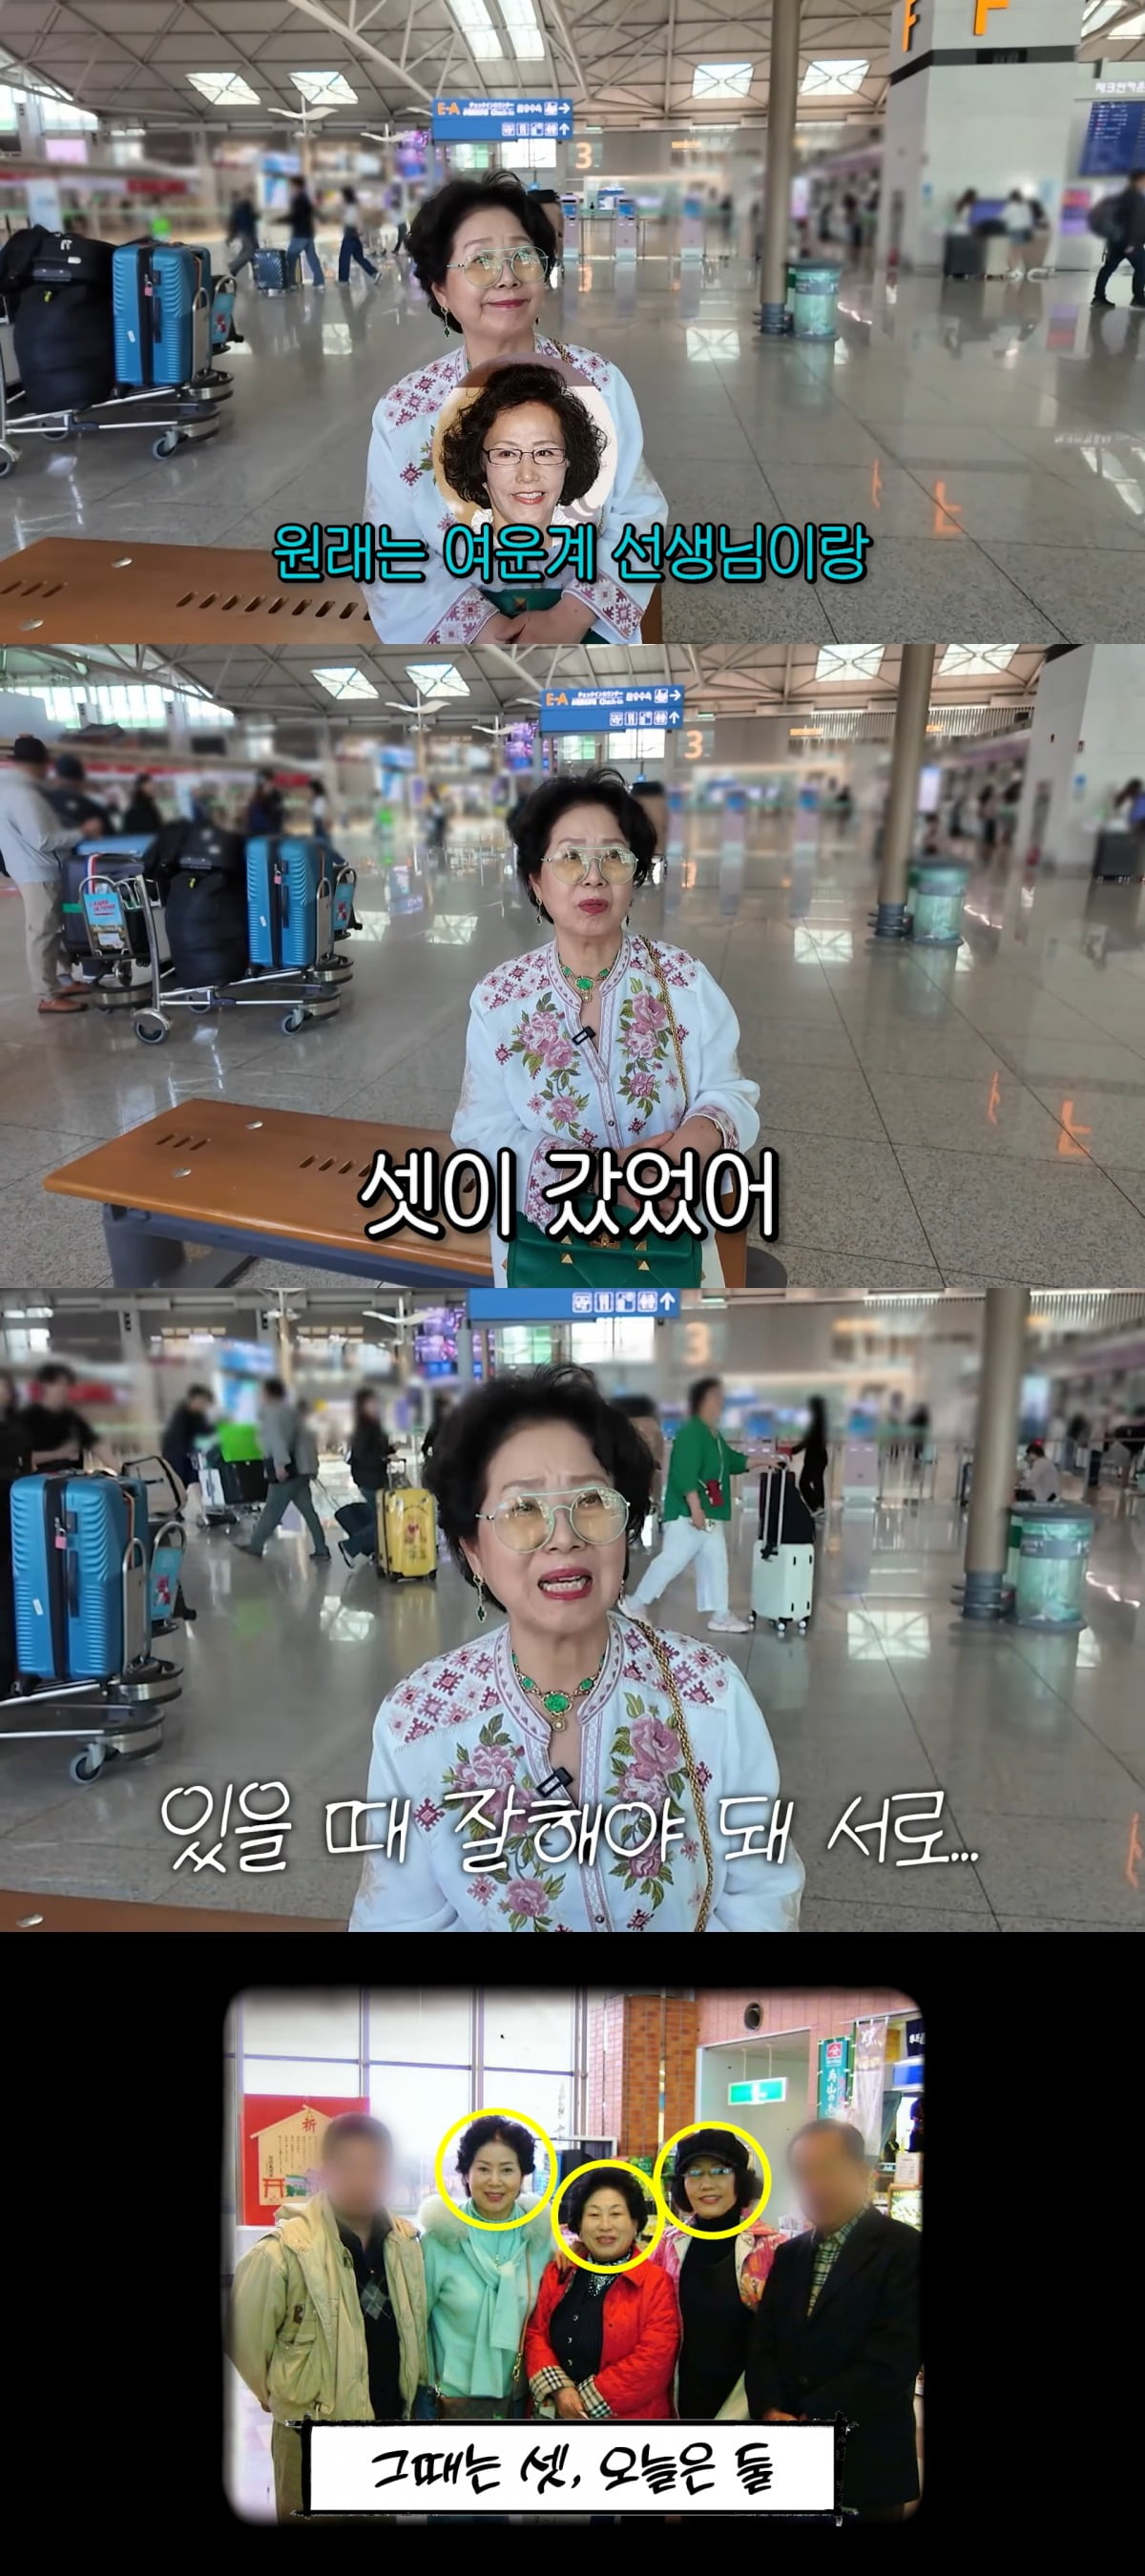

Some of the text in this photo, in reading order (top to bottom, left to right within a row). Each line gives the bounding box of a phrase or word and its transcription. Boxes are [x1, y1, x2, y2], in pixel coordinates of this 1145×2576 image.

[575, 141, 593, 169] 3
[546, 693, 569, 705] E-A
[684, 730, 703, 759] 3
